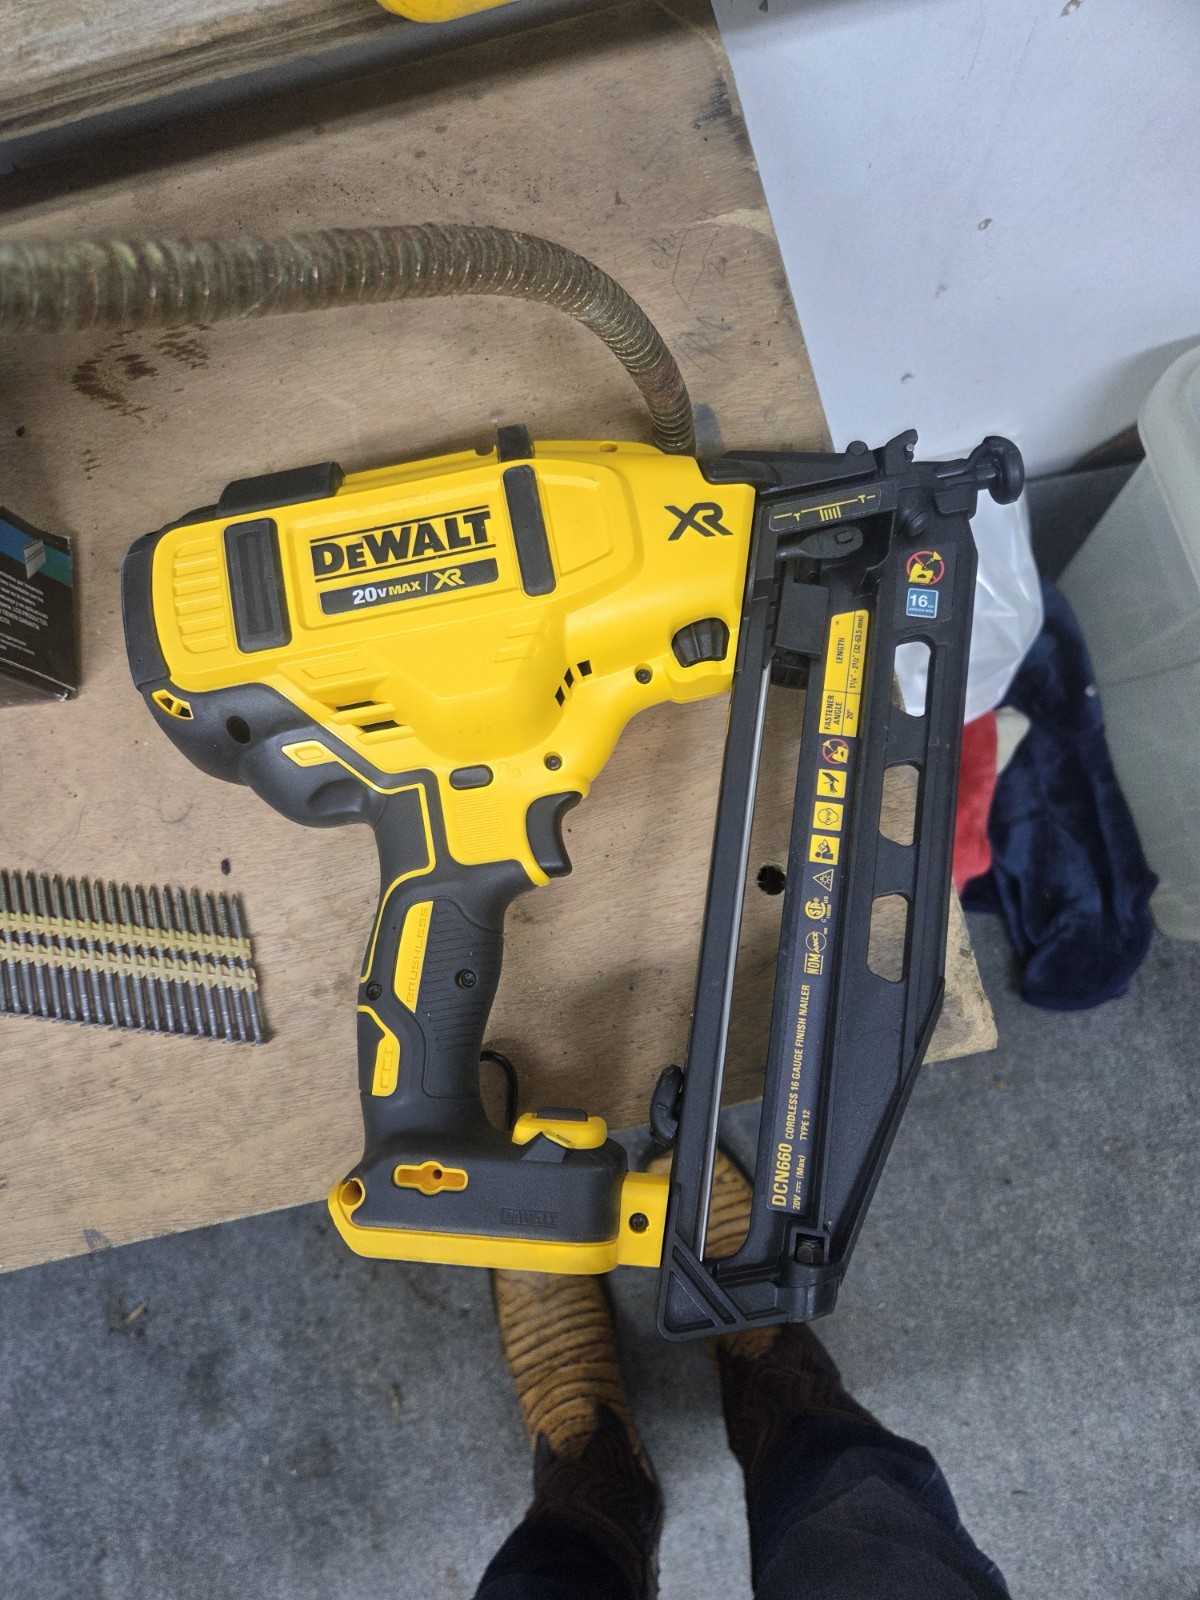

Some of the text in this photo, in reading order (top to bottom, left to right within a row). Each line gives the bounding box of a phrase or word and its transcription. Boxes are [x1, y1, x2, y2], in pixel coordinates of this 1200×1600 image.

[664, 501, 734, 541] XR
[432, 568, 466, 590] XR
[909, 594, 928, 608] 16
[835, 637, 845, 664] LENGTH
[824, 694, 835, 730] FASTENER
[833, 701, 842, 725] ANGLE
[406, 907, 429, 1004] BRUSHLESS
[811, 931, 820, 954] ANCE
[806, 952, 821, 975] NOM
[771, 984, 811, 1207] DCN660 CORDLESS 16 GAUGE FINISH NAILER
[792, 1109, 811, 1210] 20V (Max) TYPE 12
